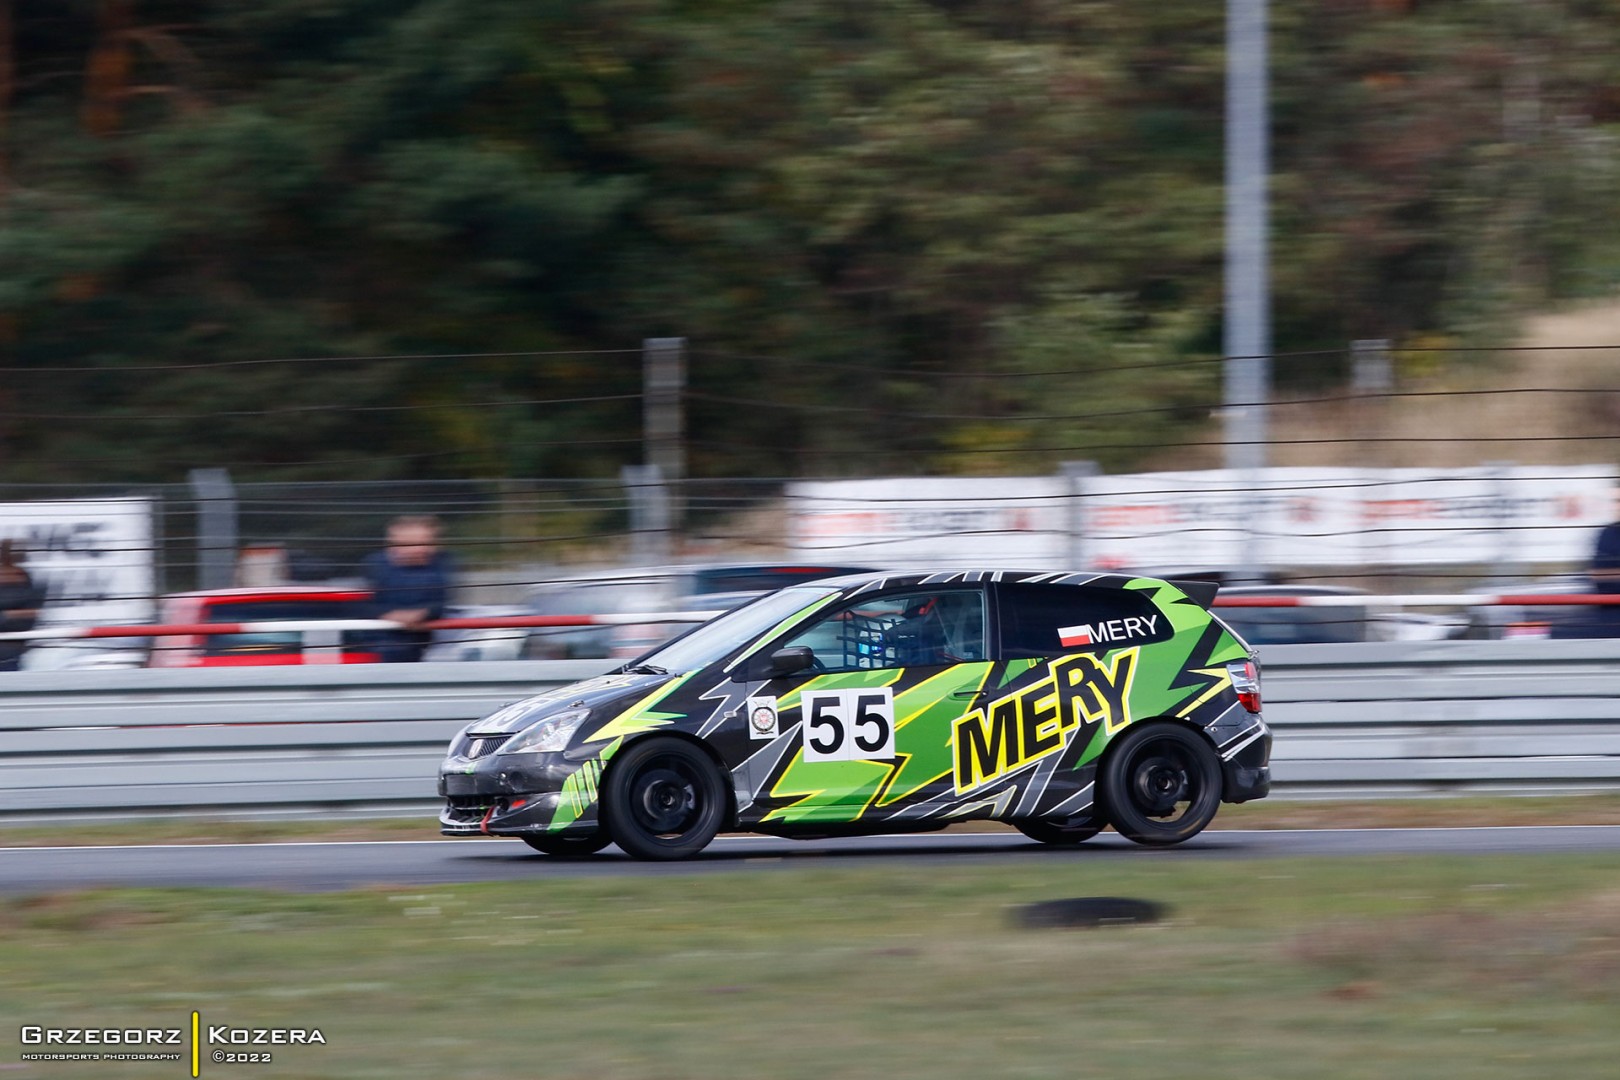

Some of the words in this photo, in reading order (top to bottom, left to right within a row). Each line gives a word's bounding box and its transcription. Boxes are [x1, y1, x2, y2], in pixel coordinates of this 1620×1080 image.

[1086, 614, 1158, 644] MERY
[809, 694, 890, 755] 55
[953, 647, 1139, 795] MERY
